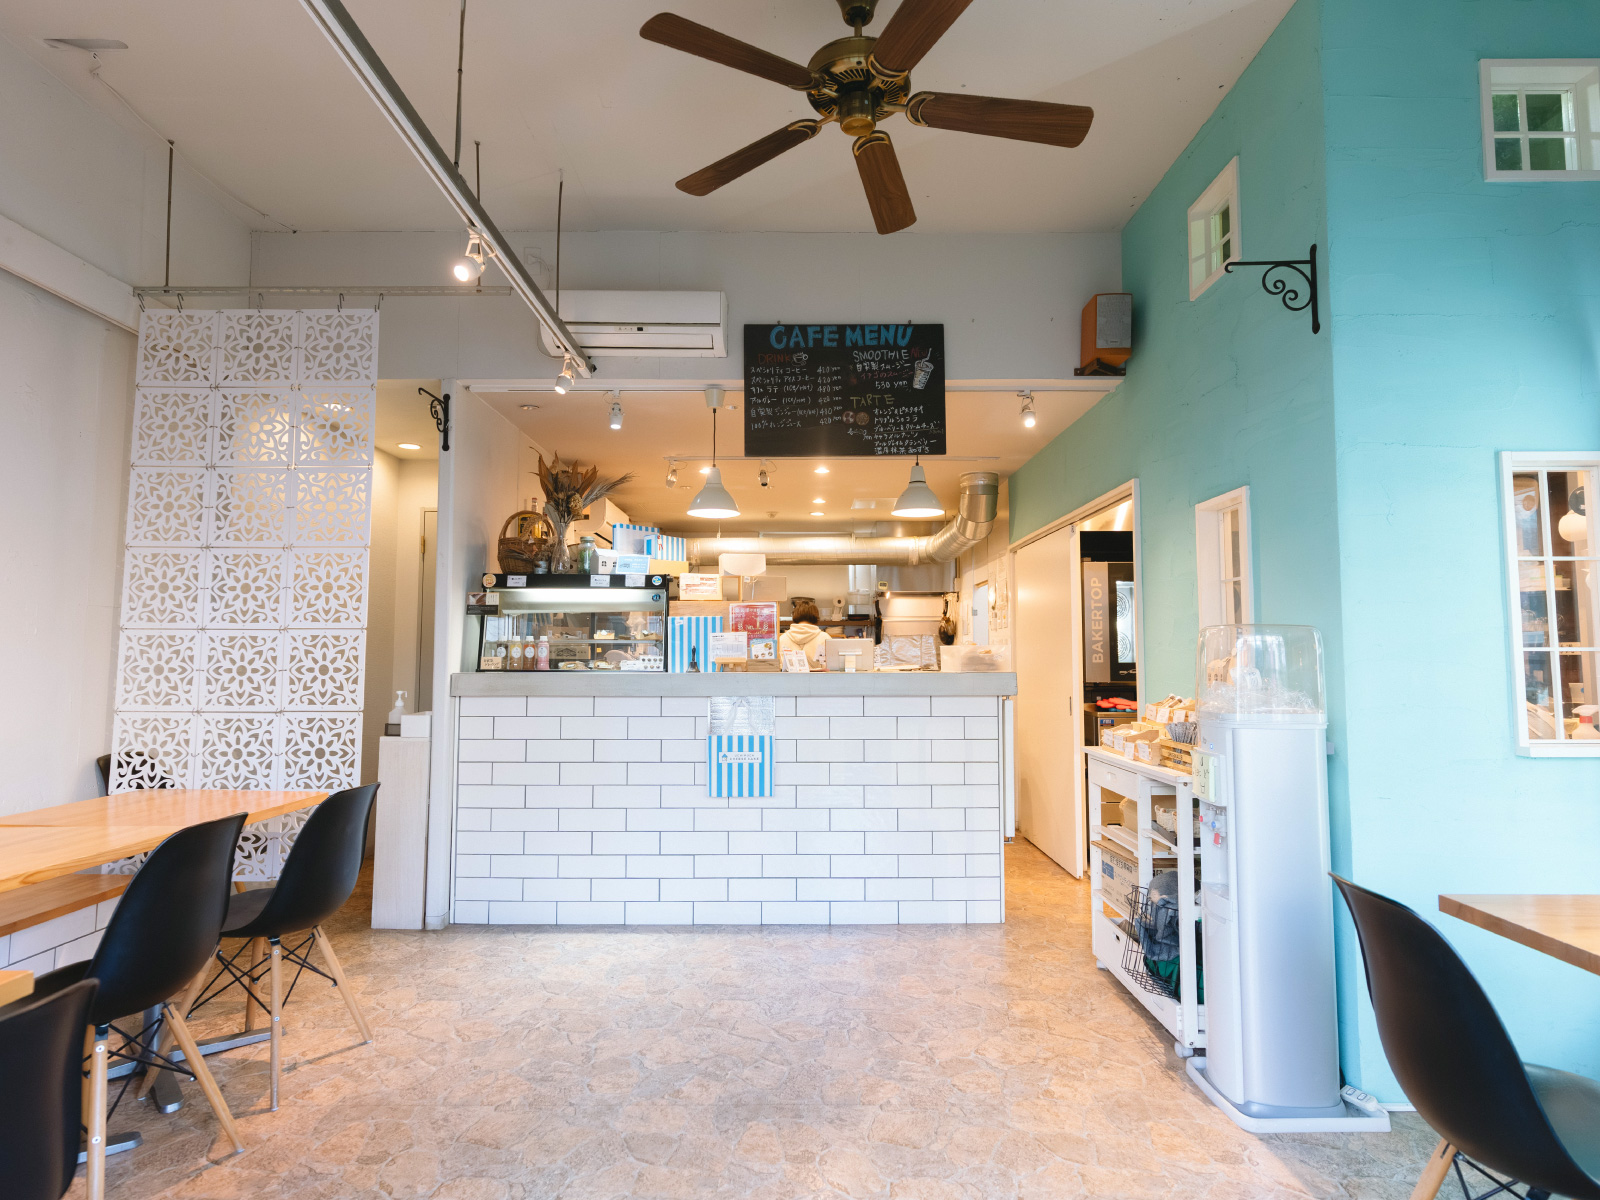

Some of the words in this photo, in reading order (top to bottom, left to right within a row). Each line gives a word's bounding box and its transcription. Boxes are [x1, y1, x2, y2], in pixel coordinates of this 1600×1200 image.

[769, 325, 839, 349] CAFE
[845, 324, 914, 348] MENU
[757, 353, 791, 365] DRINK
[852, 349, 909, 362] SMOOTHIE
[849, 393, 895, 408] TARTE
[1090, 577, 1104, 663] BAKERTOP
